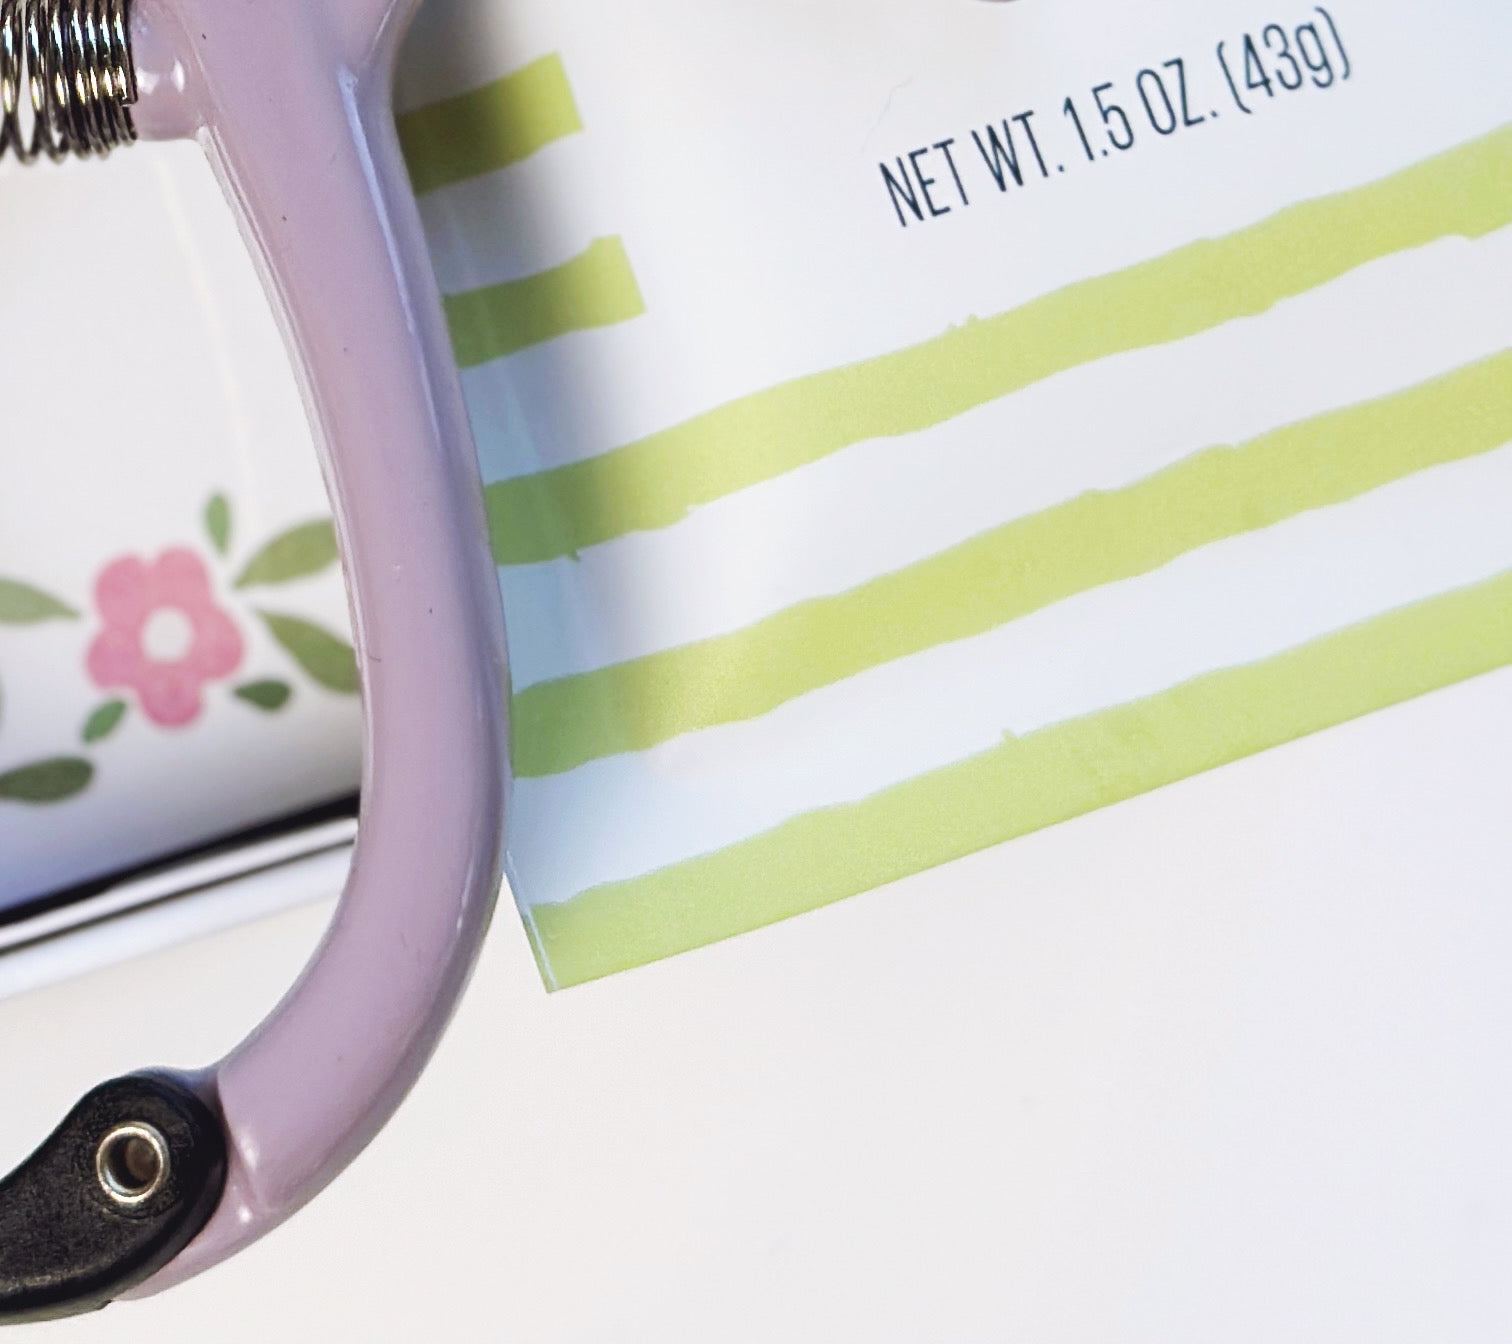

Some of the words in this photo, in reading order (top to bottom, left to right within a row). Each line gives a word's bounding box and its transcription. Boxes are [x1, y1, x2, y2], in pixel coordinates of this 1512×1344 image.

[878, 137, 970, 228] NET
[971, 109, 1066, 193] WT.
[1063, 81, 1135, 163] 1.5
[1135, 58, 1219, 136] OZ.
[1216, 6, 1353, 115] (43g)
